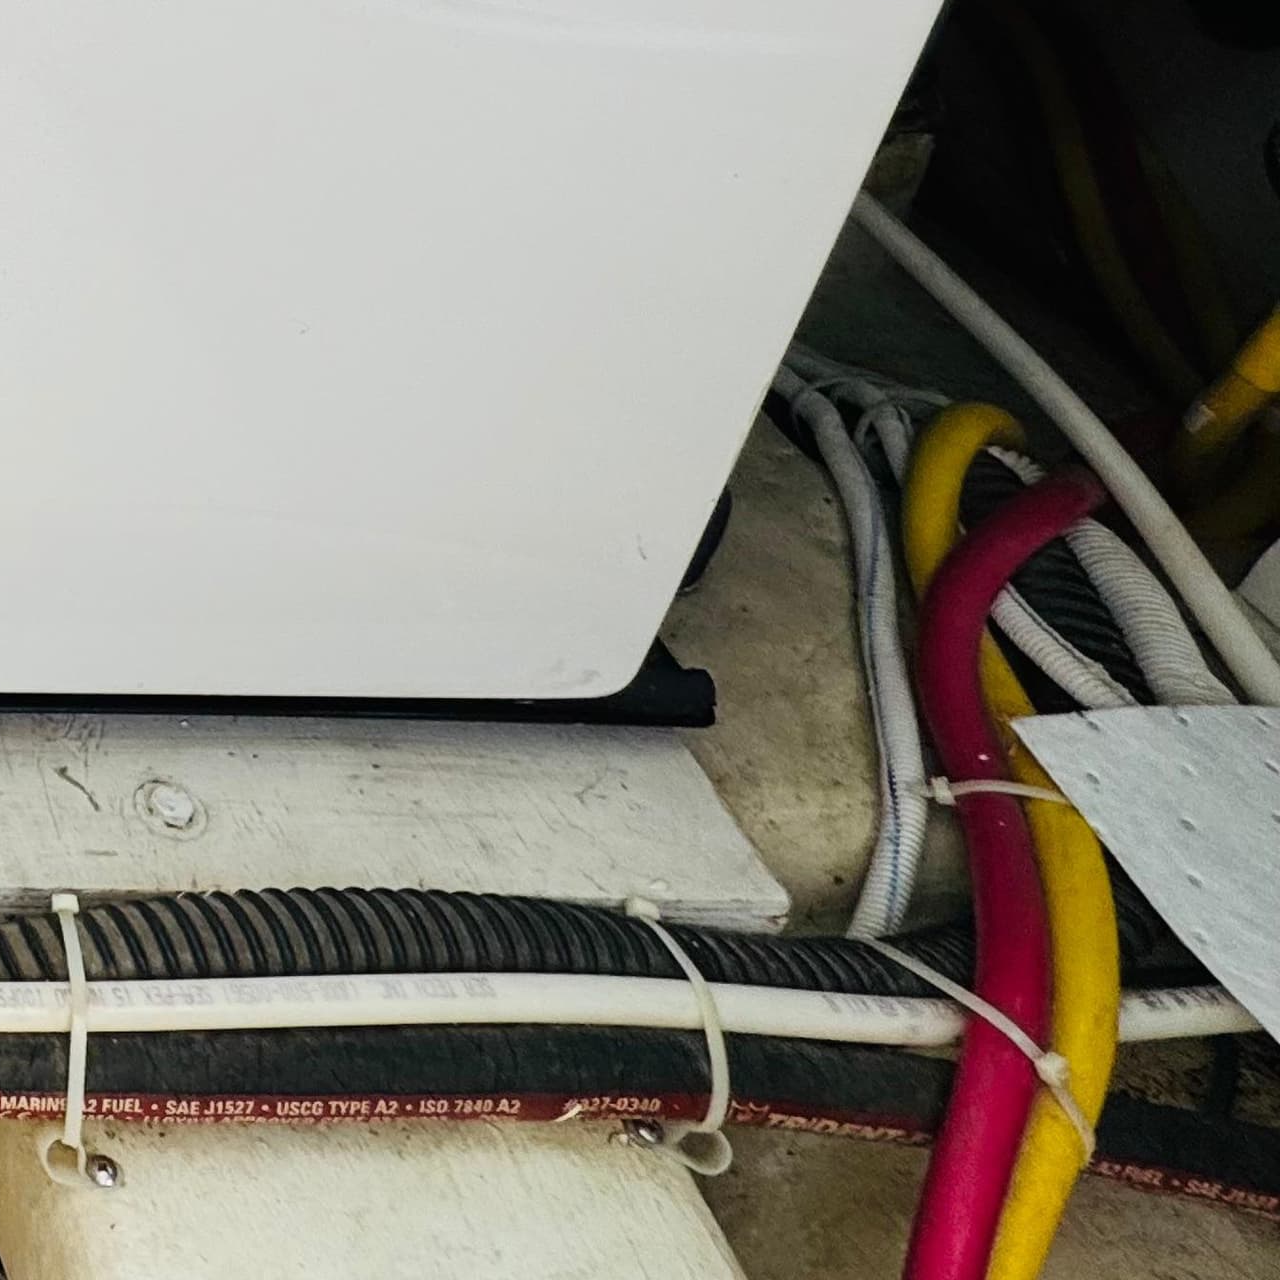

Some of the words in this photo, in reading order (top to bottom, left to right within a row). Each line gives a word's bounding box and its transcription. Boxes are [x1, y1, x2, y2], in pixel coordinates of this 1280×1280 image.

[101, 1098, 143, 1113] FUEL
[165, 1100, 200, 1115] SAE
[204, 1100, 255, 1115] J1527
[277, 1101, 323, 1116] USCG
[328, 1101, 371, 1116] TYPE
[374, 1100, 399, 1114] A2
[419, 1100, 448, 1113] ISO
[453, 1099, 493, 1114] 7840
[497, 1099, 521, 1114] A2
